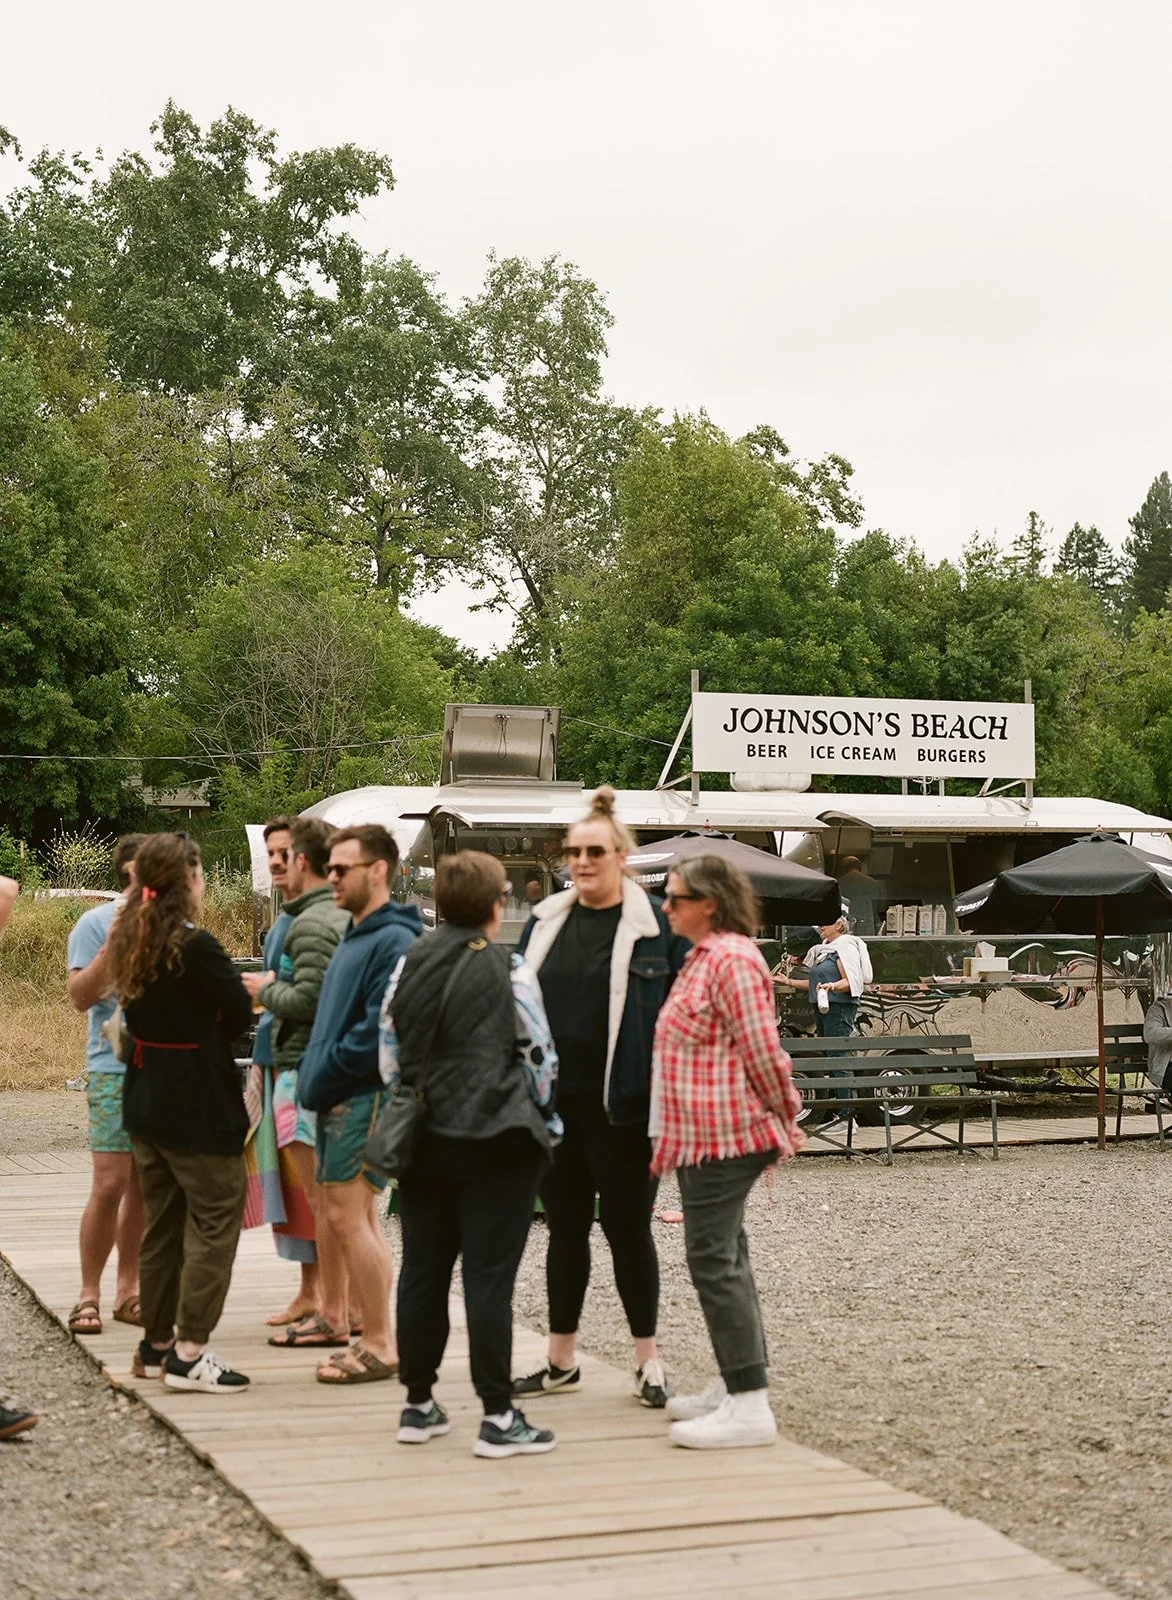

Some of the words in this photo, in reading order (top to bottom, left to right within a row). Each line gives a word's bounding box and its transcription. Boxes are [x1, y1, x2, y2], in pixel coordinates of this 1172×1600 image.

[722, 707, 901, 738] JOHNSON'S
[910, 713, 1009, 741] BEACH
[746, 743, 788, 759] BEER
[810, 745, 835, 760] ICE
[841, 746, 897, 761] CREAM
[917, 748, 986, 764] BURGERS
